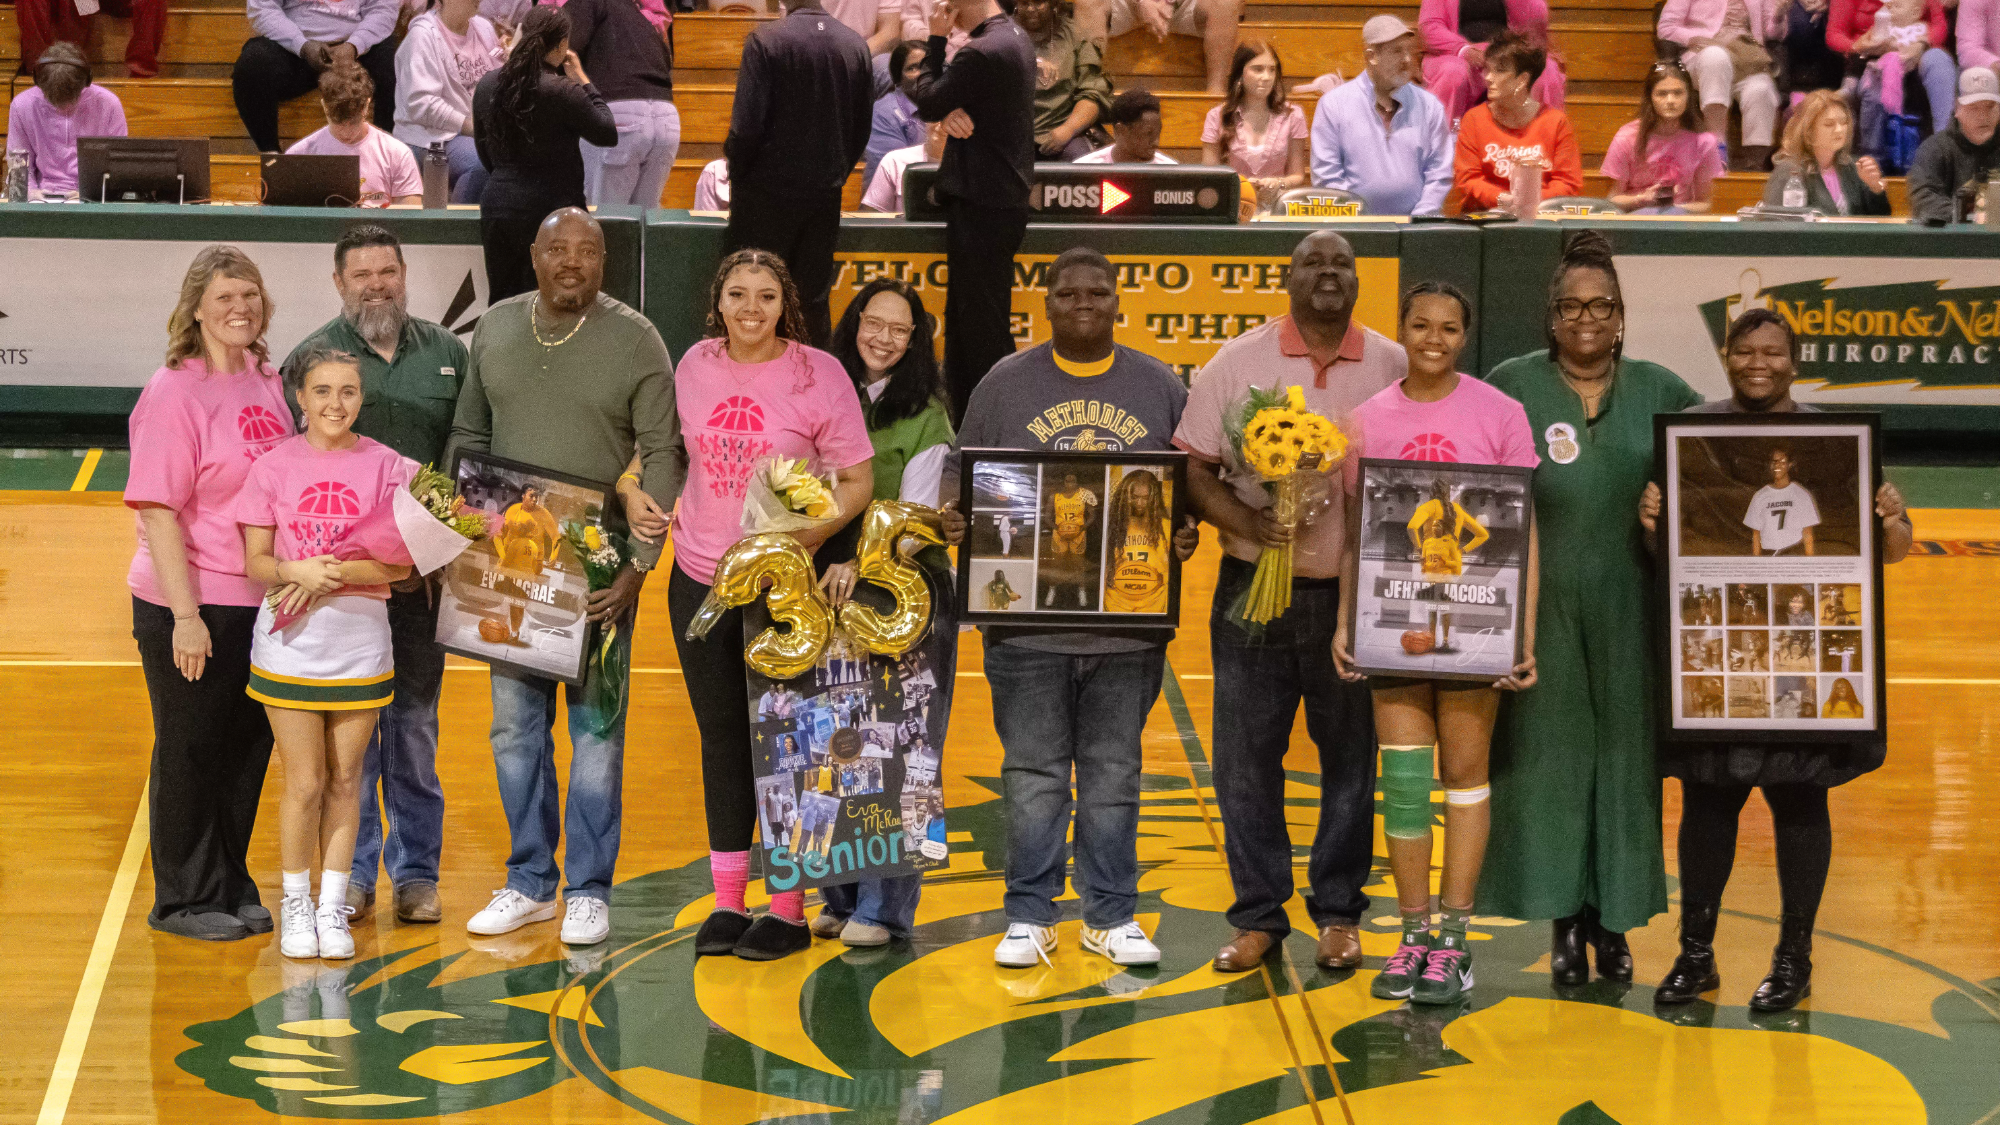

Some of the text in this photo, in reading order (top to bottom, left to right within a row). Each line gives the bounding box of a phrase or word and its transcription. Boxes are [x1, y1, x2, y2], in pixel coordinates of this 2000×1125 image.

[1482, 143, 1543, 162] Raising
[1044, 185, 1195, 208] POSS BONUS
[1284, 196, 1361, 216] METHODIST
[1026, 400, 1148, 446] METHODIST
[1771, 510, 1786, 530] 7
[846, 800, 885, 819] Eva
[769, 826, 905, 891] Senior
